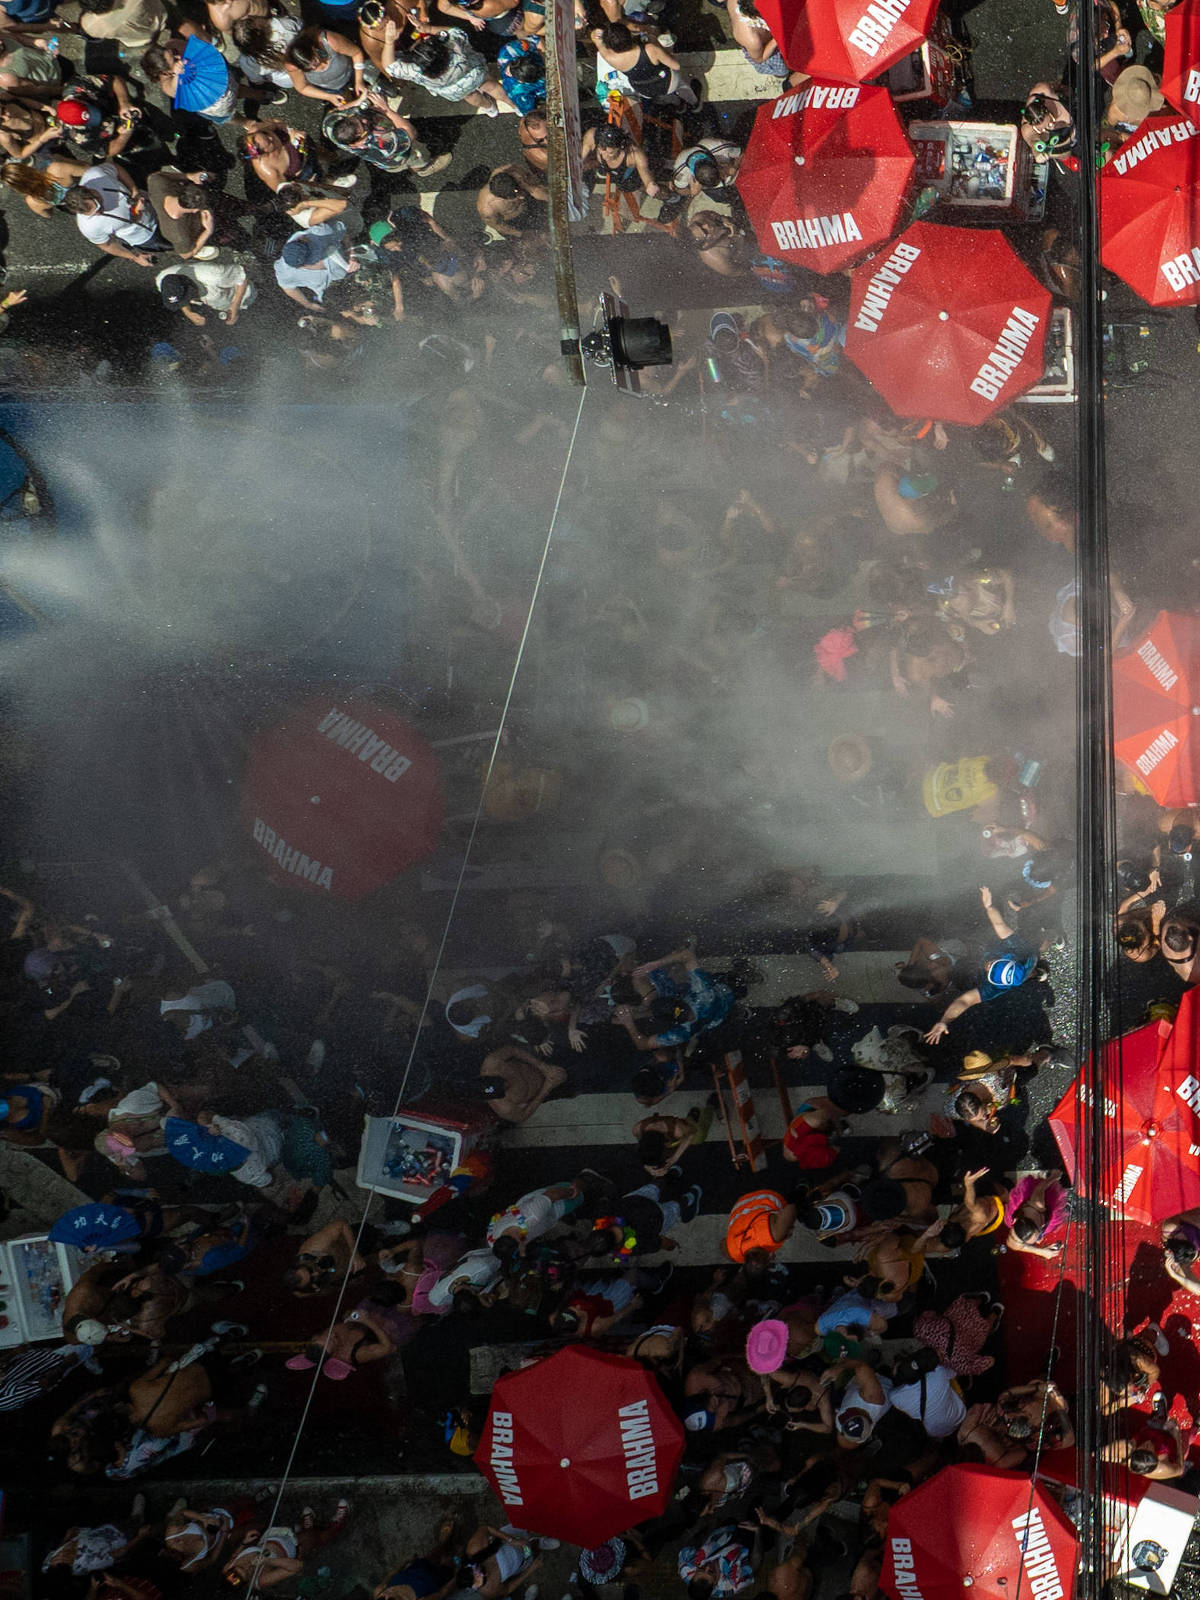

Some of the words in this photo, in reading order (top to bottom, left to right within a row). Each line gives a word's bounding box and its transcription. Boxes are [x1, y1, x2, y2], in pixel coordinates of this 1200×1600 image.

[848, 0, 910, 57] BRAH
[772, 86, 860, 119] BRAHMA
[771, 213, 862, 249] BRAHMA
[854, 243, 920, 332] BRAHMA
[970, 307, 1042, 402] BRAHMA
[1137, 640, 1178, 691] BRAHMA
[1136, 730, 1178, 775] BRAHMA
[253, 817, 333, 890] BRAHMA
[490, 1412, 523, 1505] BRAHMA
[619, 1400, 658, 1500] BRAHMA
